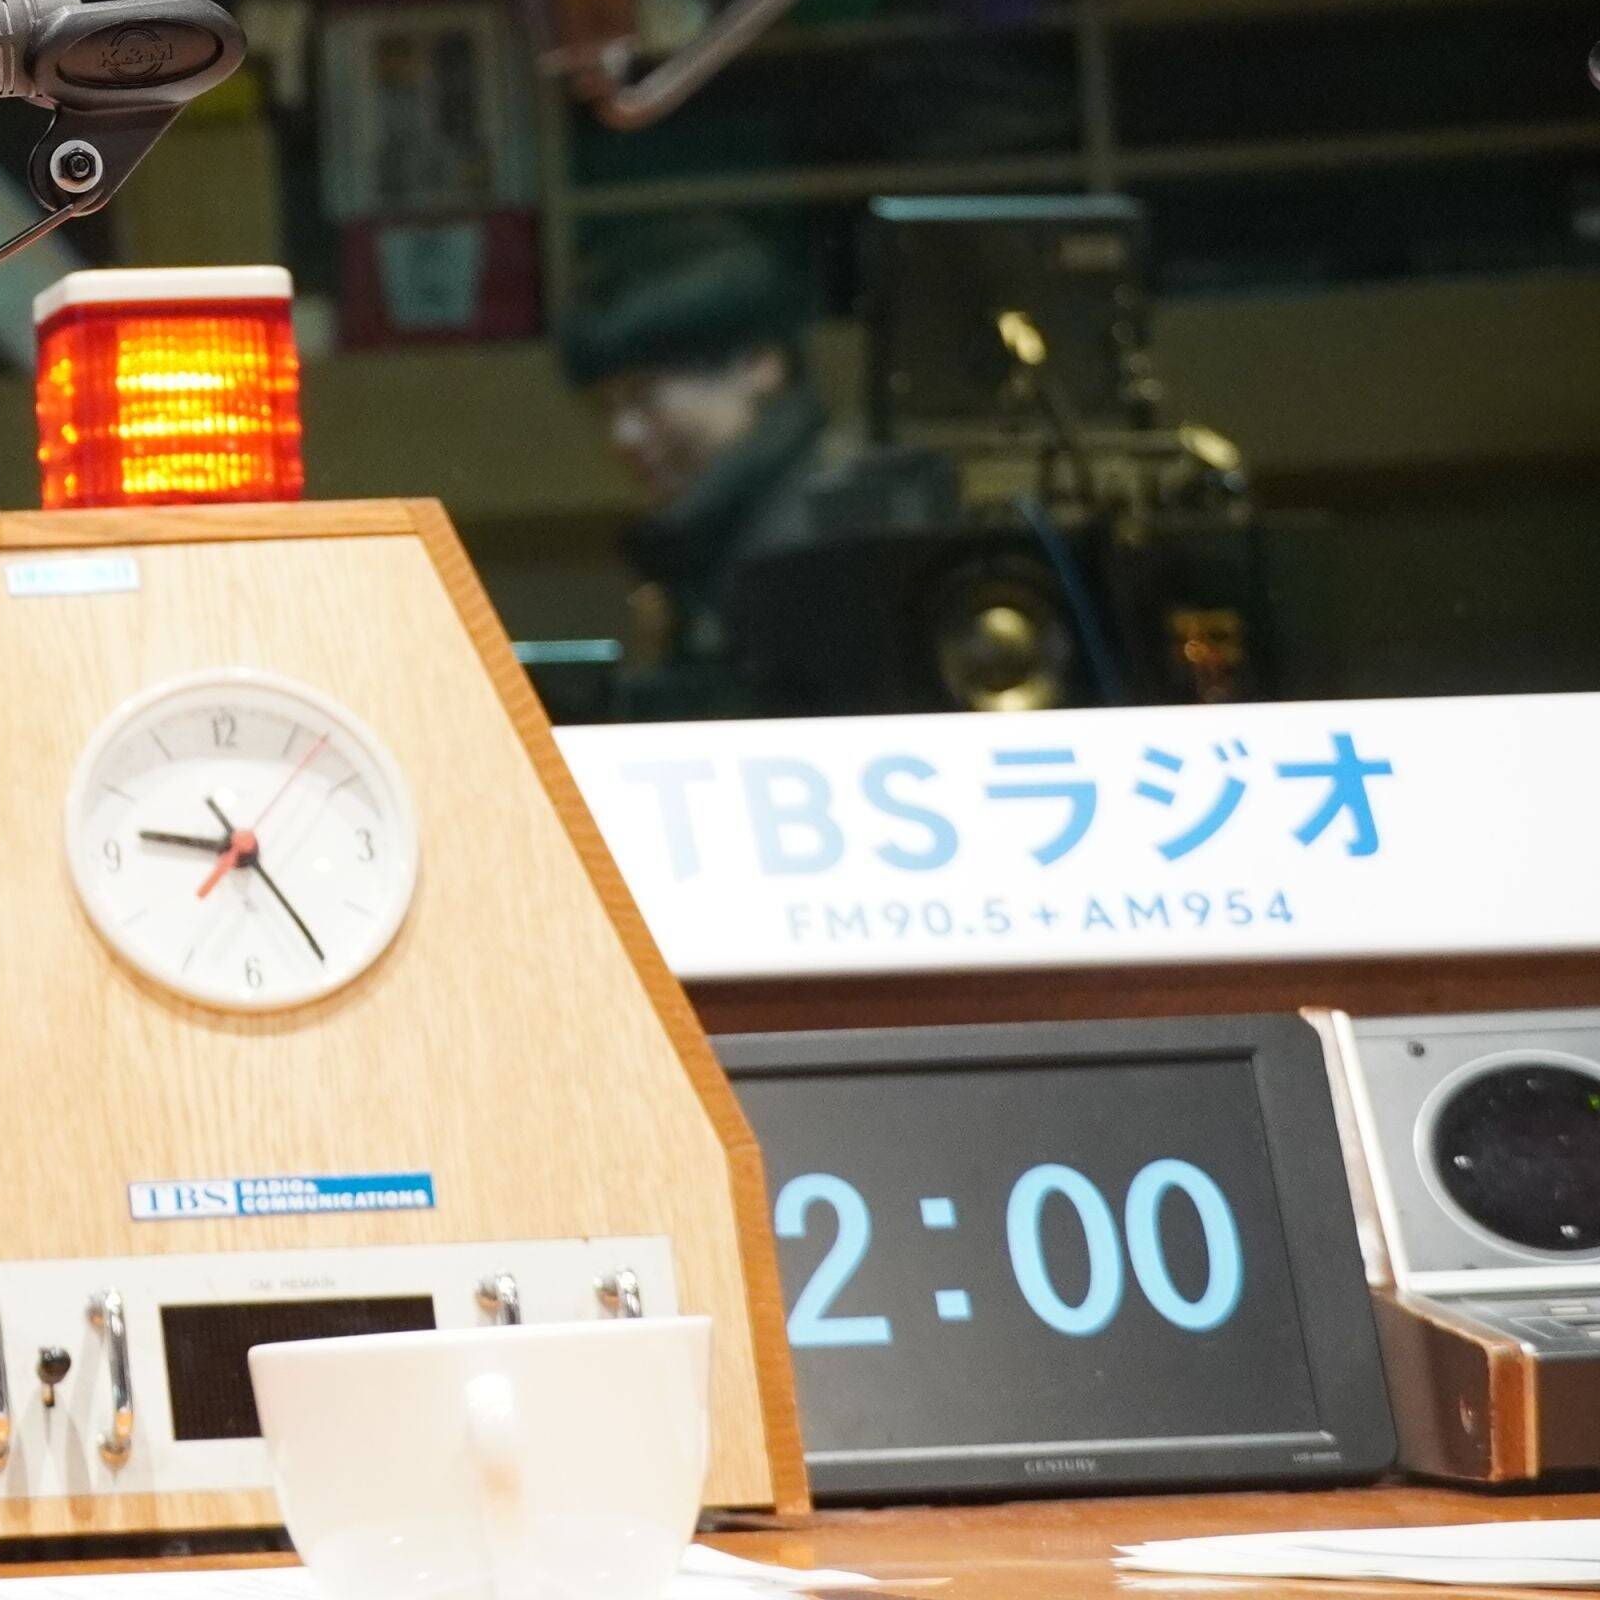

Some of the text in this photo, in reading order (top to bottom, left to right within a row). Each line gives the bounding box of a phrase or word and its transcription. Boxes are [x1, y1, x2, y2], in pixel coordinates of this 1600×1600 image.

[210, 711, 238, 748] 12
[620, 731, 1394, 881] TBSラジオ
[103, 838, 121, 873] 9
[355, 827, 375, 862] 3
[244, 956, 263, 989] 6
[141, 1182, 228, 1213] TBS
[240, 1189, 430, 1213] COMMUNICATIONS
